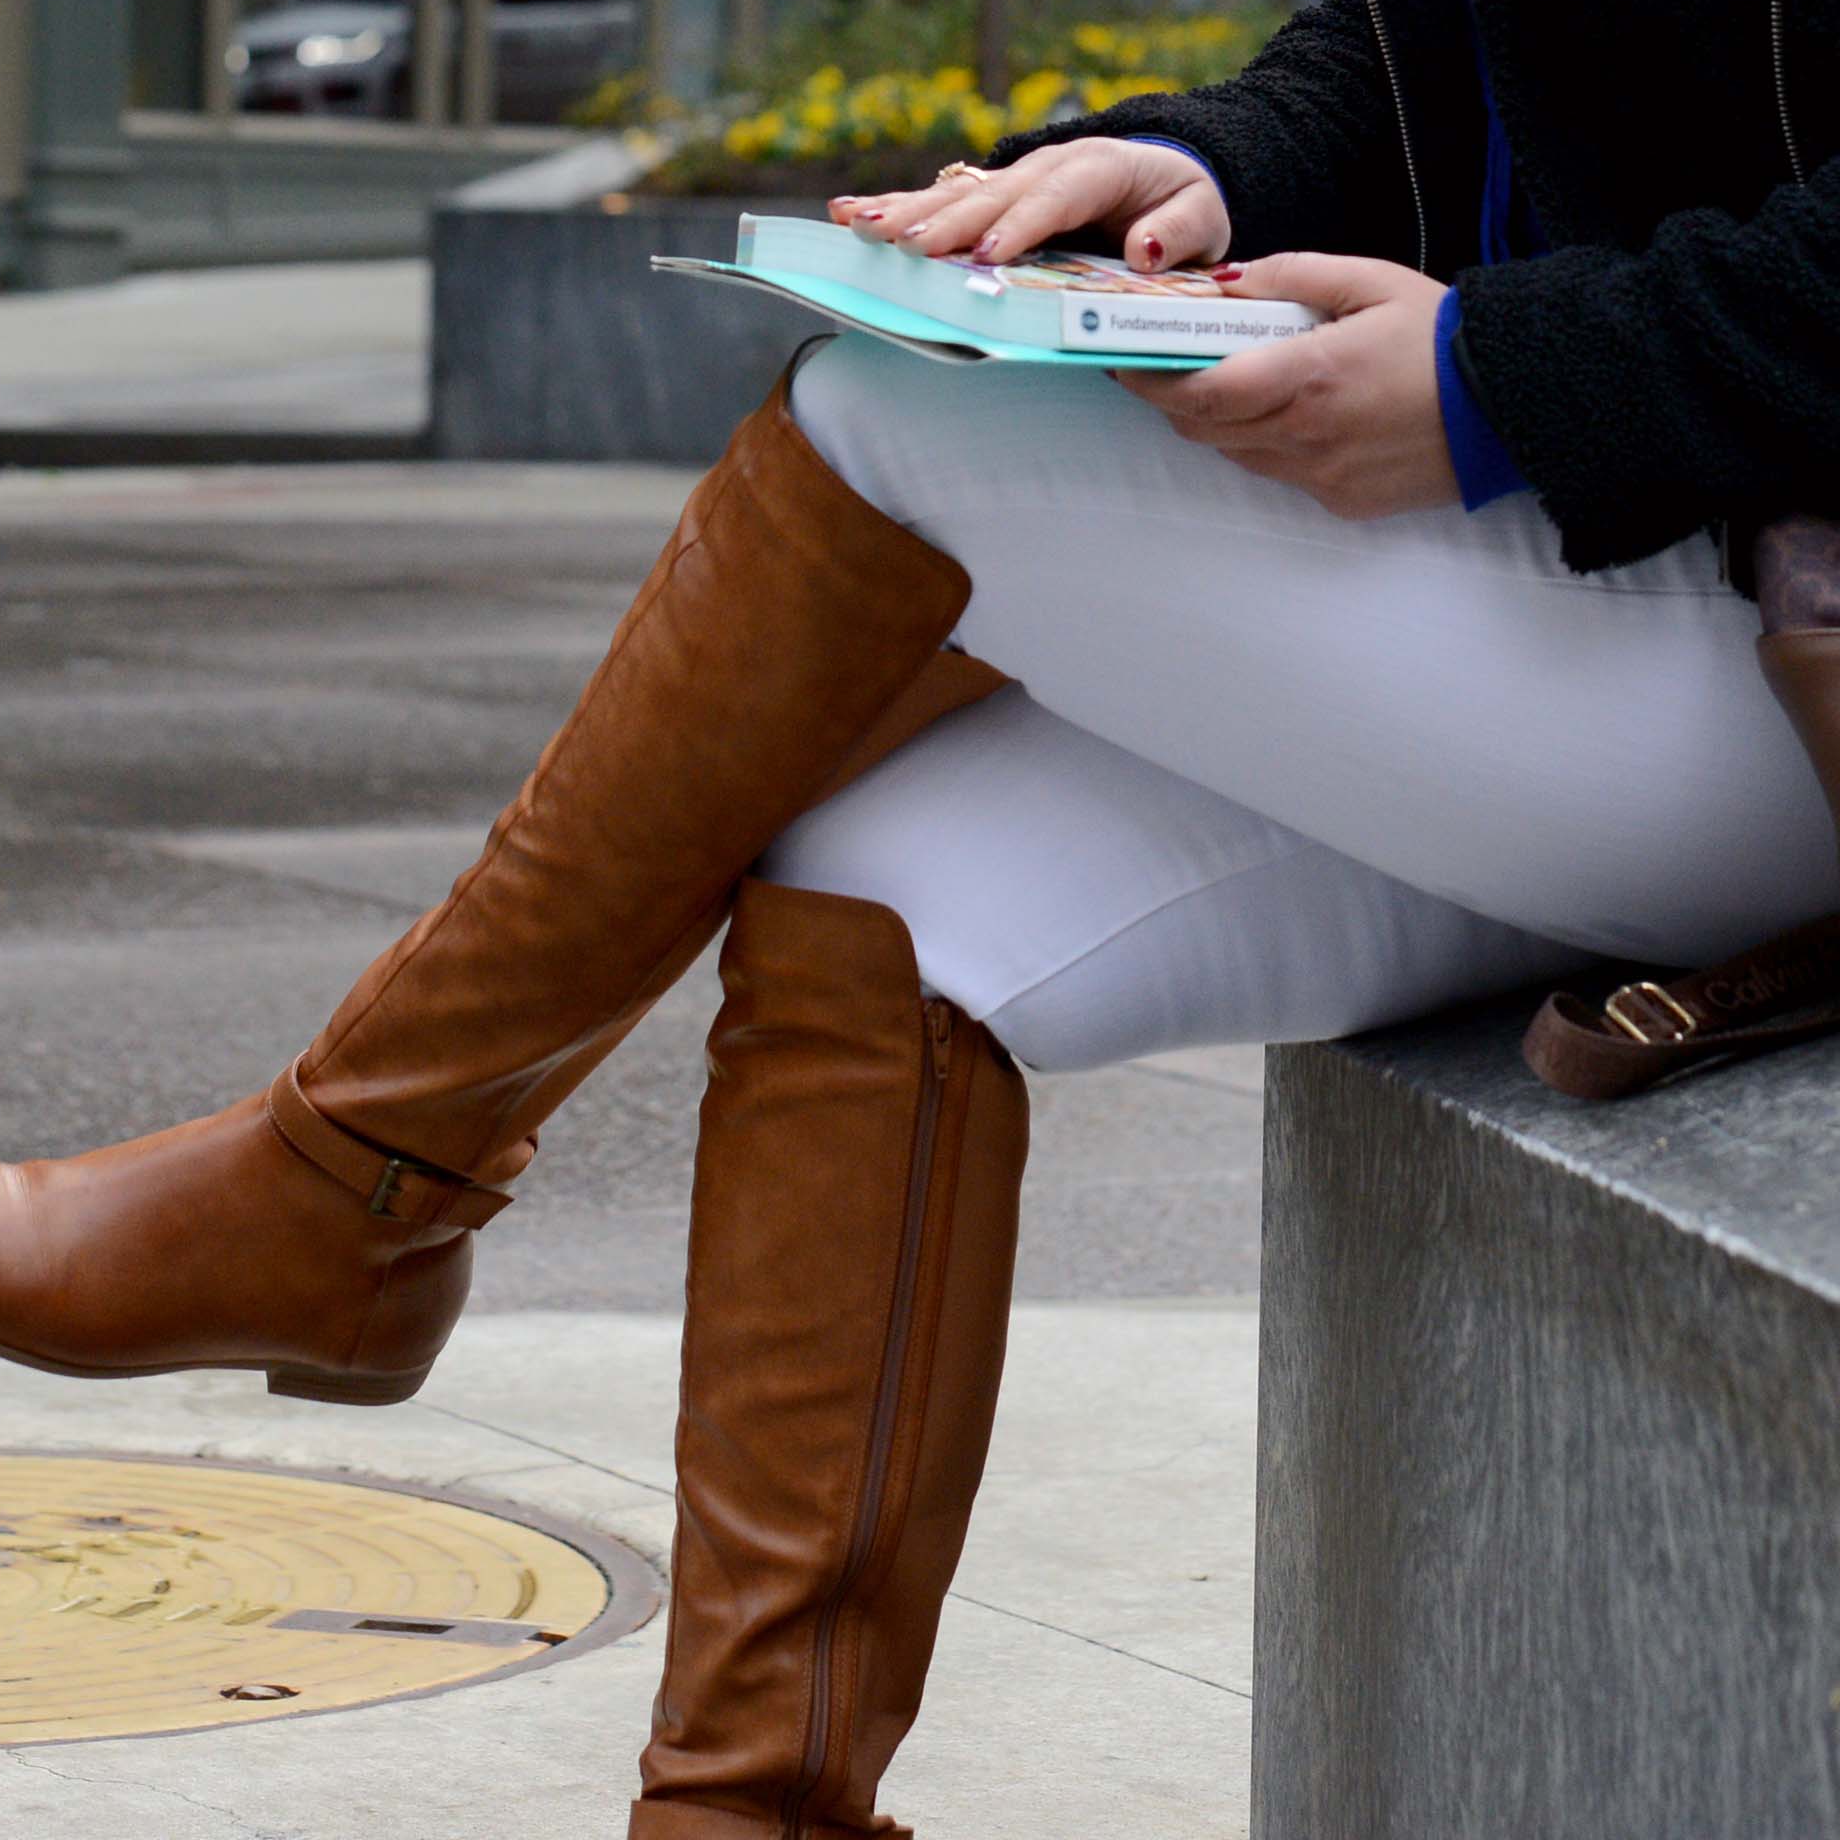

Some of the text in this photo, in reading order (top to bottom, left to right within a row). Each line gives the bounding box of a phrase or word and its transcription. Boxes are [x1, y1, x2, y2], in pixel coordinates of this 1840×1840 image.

[1109, 313, 1191, 334] Fundamentos
[1194, 321, 1221, 339] para
[1223, 319, 1270, 338] trabajar
[1272, 324, 1295, 337] con
